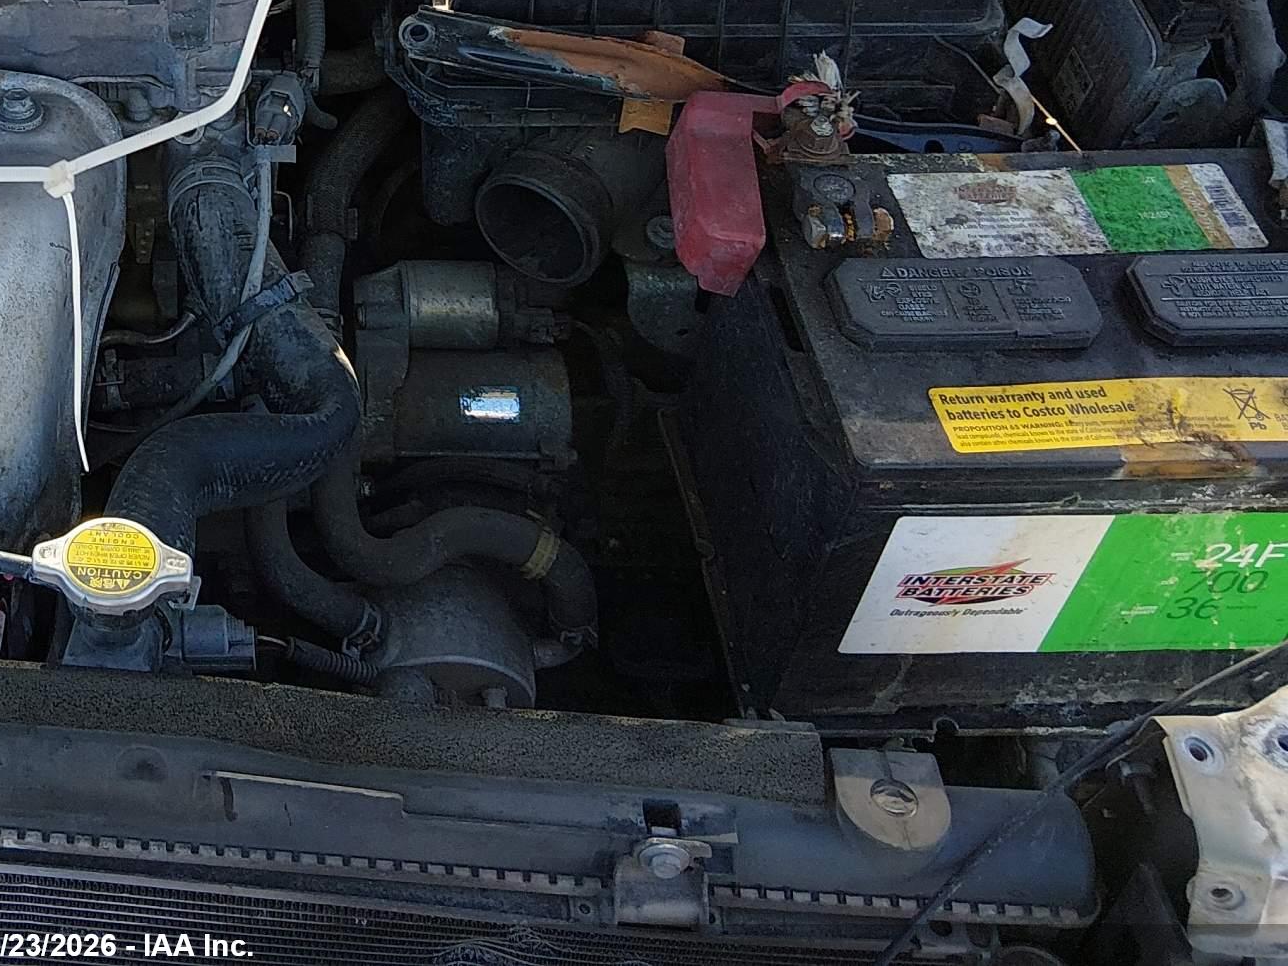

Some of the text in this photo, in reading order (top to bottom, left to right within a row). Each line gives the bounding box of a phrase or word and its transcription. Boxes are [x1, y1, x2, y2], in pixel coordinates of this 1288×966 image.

[896, 266, 960, 279] DANGER
[976, 265, 1034, 277] POISON
[939, 386, 1108, 405] Return warranty and used
[945, 400, 1136, 421] batteries to Costco Wholesale
[952, 424, 1009, 432] PROPOSITION
[1248, 422, 1267, 431] Pb
[77, 567, 143, 580] CAUTION
[902, 574, 1047, 586] INTERSTATE
[1183, 570, 1269, 594] 700
[901, 585, 1029, 597] BATTERIES
[889, 606, 1025, 618] Outrageously Dependable
[1166, 597, 1223, 619] 36
